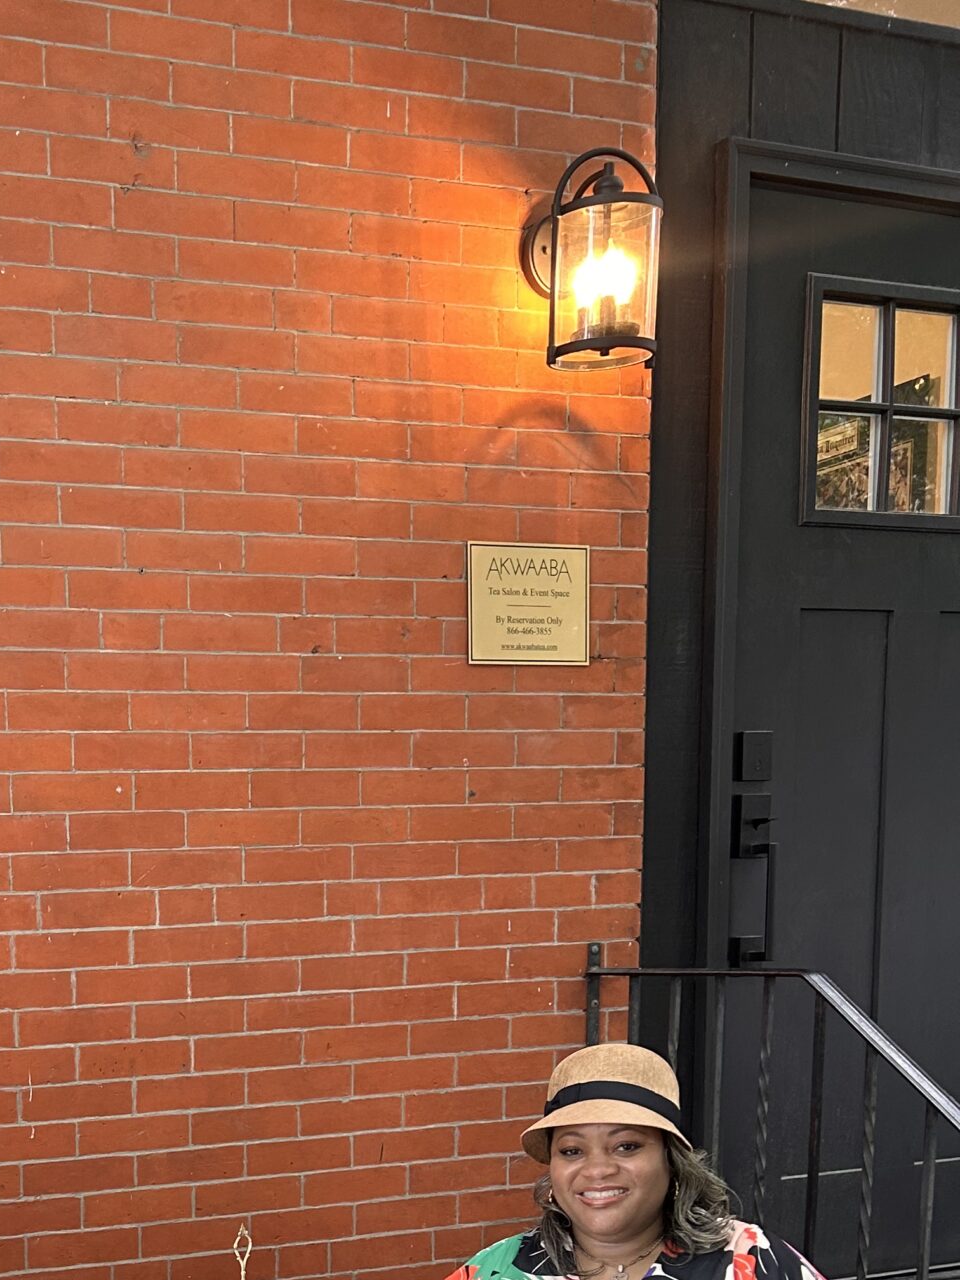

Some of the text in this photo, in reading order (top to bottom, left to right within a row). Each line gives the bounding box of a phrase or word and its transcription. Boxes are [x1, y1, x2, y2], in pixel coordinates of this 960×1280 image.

[485, 557, 573, 583] AKWAABA
[488, 587, 570, 599] Tea Salon & Event Space
[495, 615, 563, 626] By Reservation Only
[506, 627, 552, 635] 866-466-3855
